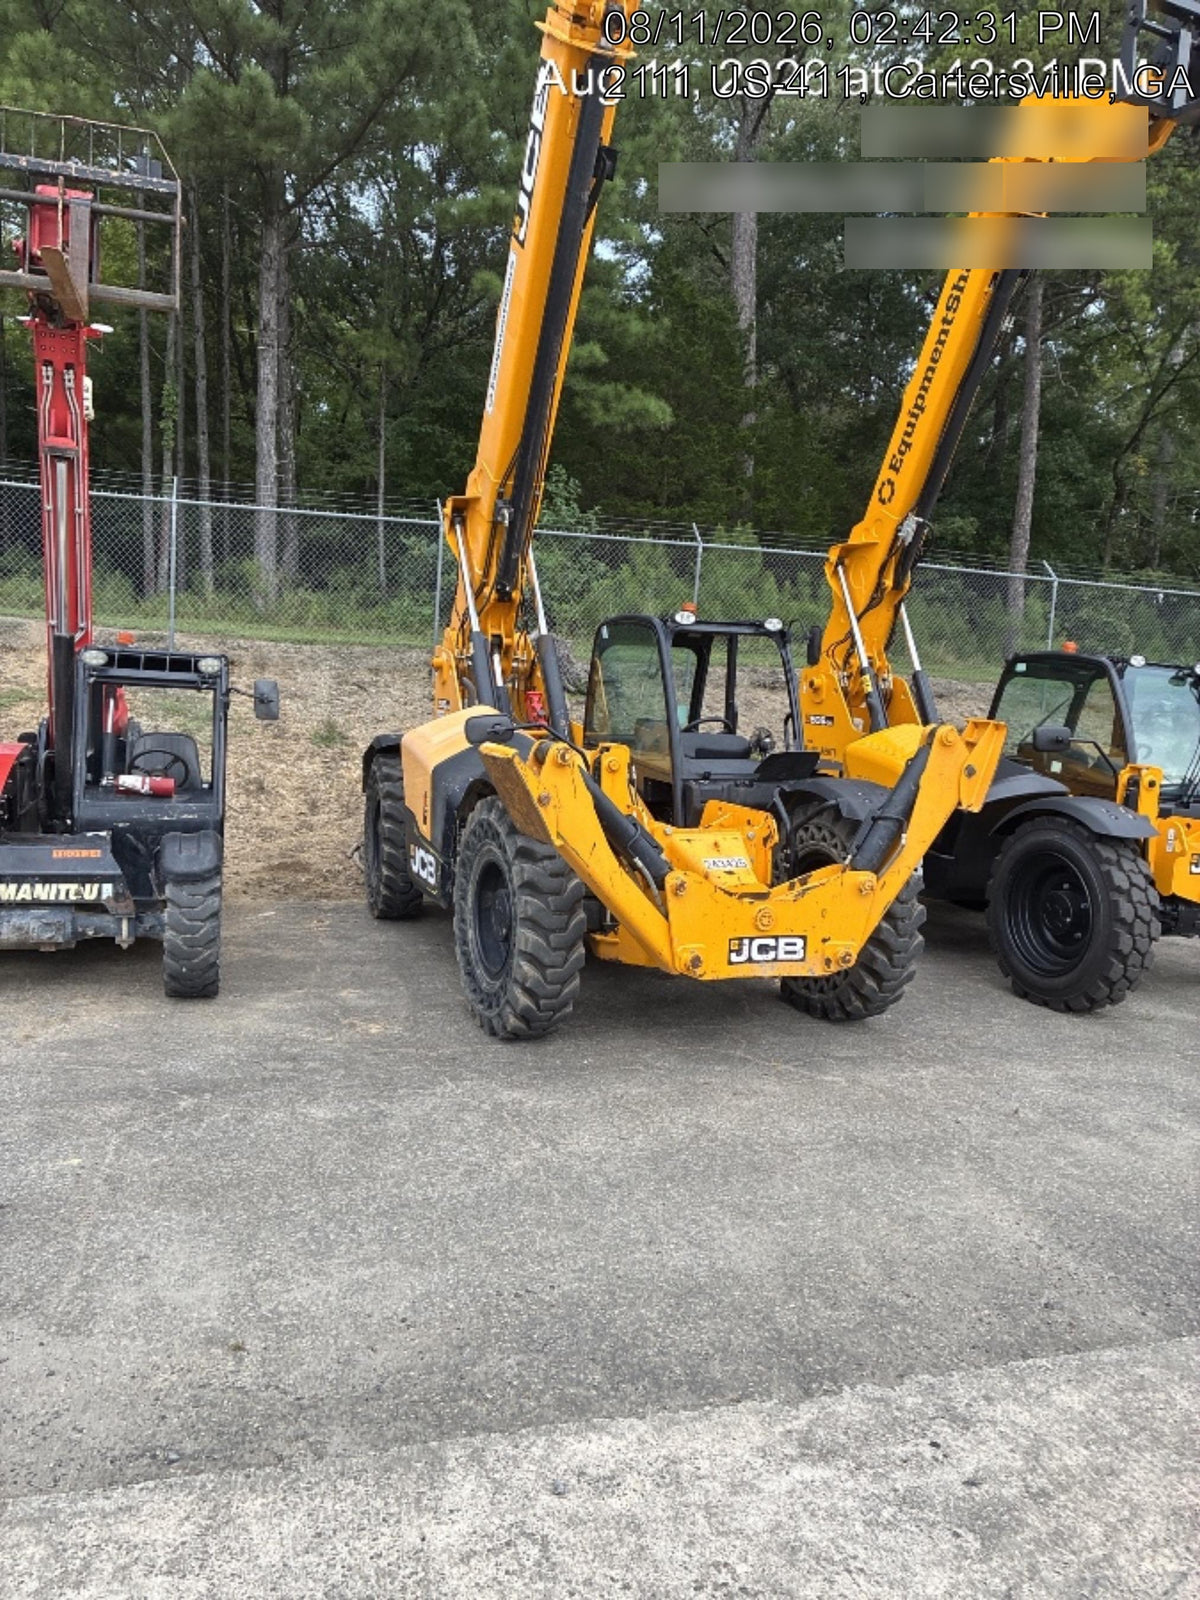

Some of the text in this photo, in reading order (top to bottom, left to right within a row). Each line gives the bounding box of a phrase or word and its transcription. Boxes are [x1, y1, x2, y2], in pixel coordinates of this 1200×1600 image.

[516, 64, 551, 241] JCB
[888, 268, 972, 475] EquipmentSh
[410, 845, 437, 886] JCB
[730, 936, 805, 963] JCB
